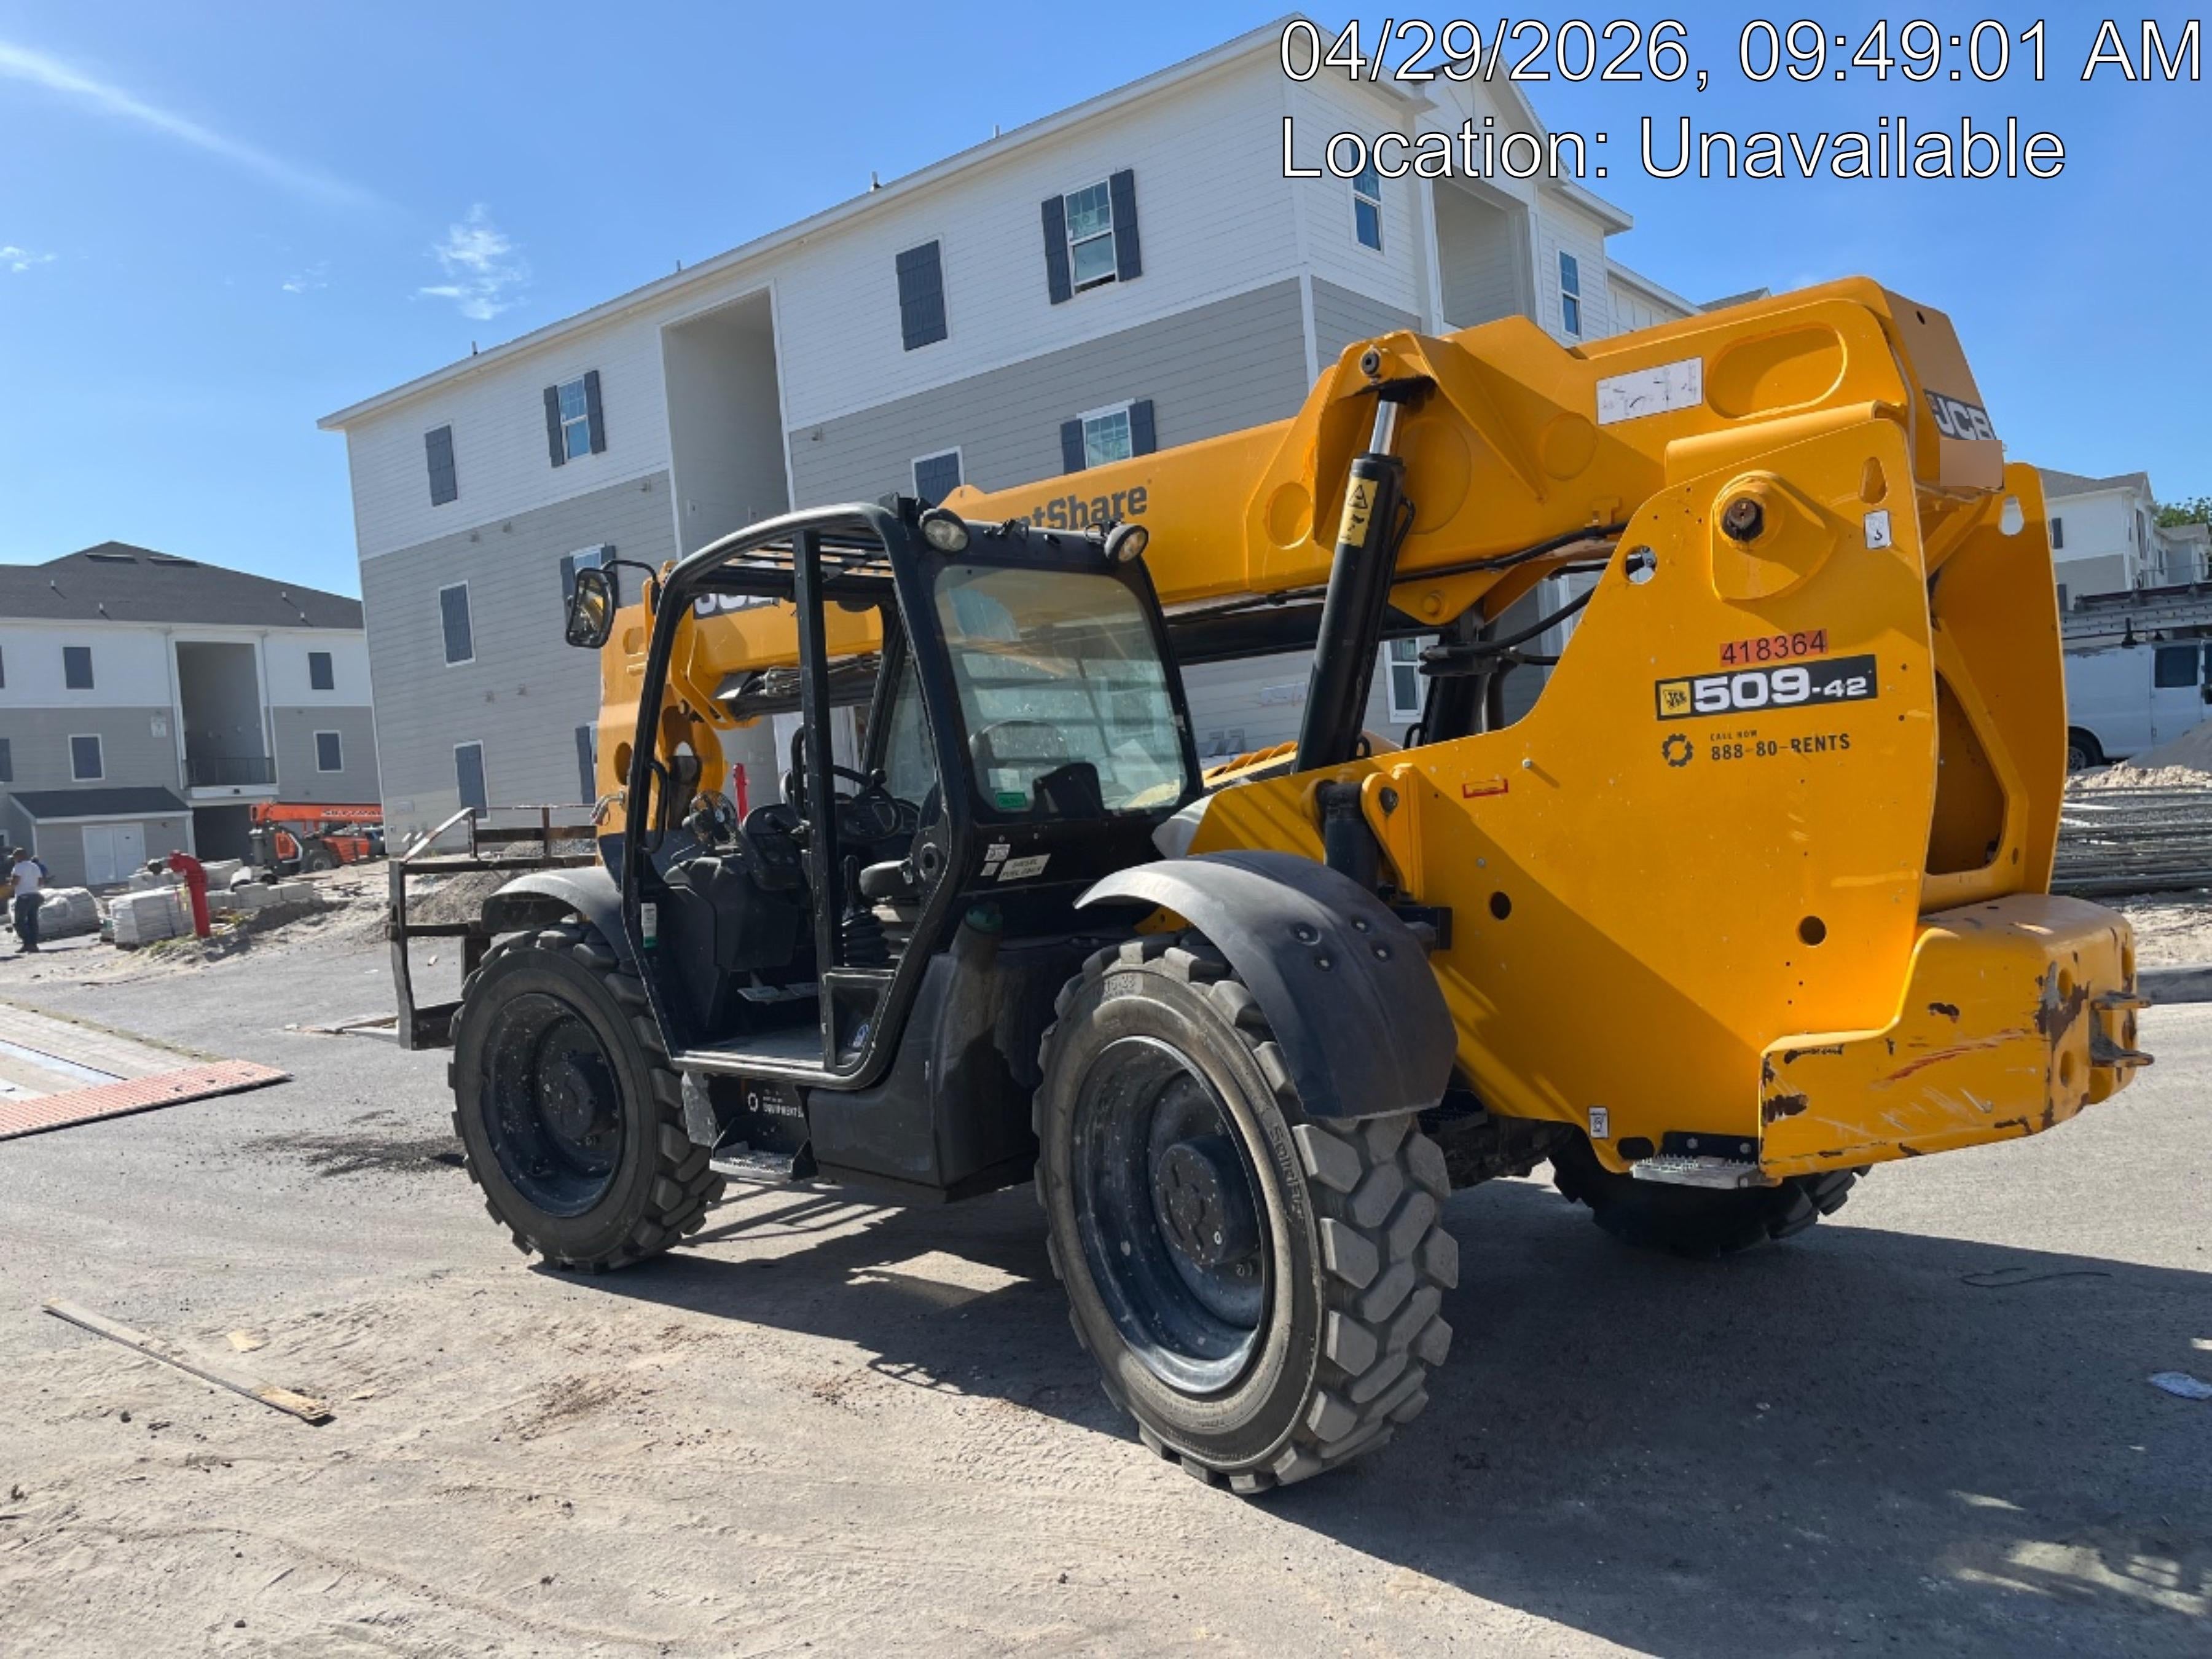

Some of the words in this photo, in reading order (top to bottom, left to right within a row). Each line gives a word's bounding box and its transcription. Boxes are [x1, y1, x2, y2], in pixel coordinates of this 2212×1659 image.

[1935, 397, 1996, 440] JCB
[1721, 629, 1827, 664] 418364
[1693, 667, 1868, 712] 509-42
